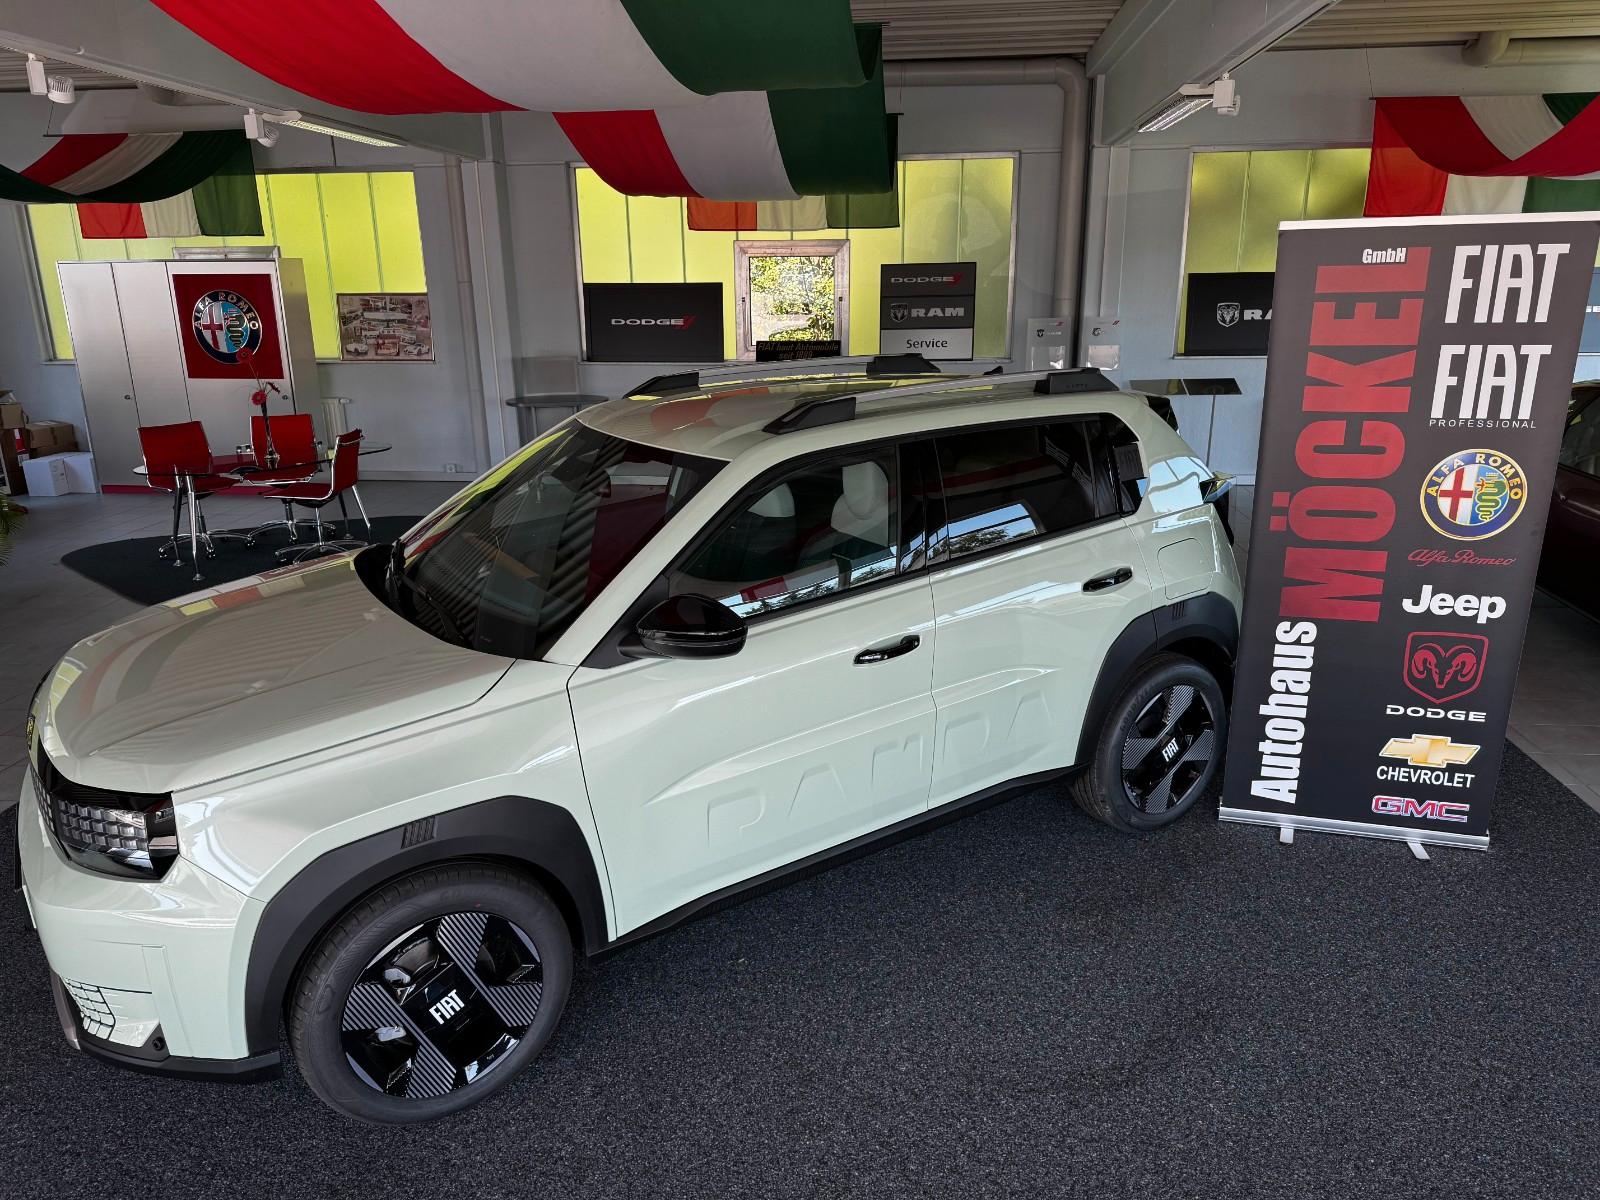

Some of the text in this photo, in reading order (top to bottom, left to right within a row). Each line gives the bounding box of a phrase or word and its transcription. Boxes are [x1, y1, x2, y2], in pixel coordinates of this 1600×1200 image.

[1362, 247, 1407, 264] GmbH
[1445, 243, 1571, 324] FIAT
[194, 291, 259, 330] ALFA ROMEO
[911, 307, 965, 317] RAM
[757, 342, 776, 351] FIAT
[906, 338, 948, 349] Service
[1430, 344, 1553, 420] FIAT
[1429, 419, 1537, 429] PROFESSIONAL
[1426, 453, 1523, 500] ALFA ROMEO
[1250, 246, 1432, 805] Autohaus MÖCKEL
[1407, 549, 1517, 567] Alfa Romeo
[1402, 584, 1507, 624] Jeep
[1386, 704, 1487, 723] DODGE
[1162, 737, 1179, 762] FIAT
[1376, 765, 1475, 788] CHEVROLET
[1371, 794, 1471, 822] GMC
[429, 989, 465, 1025] FIAT
